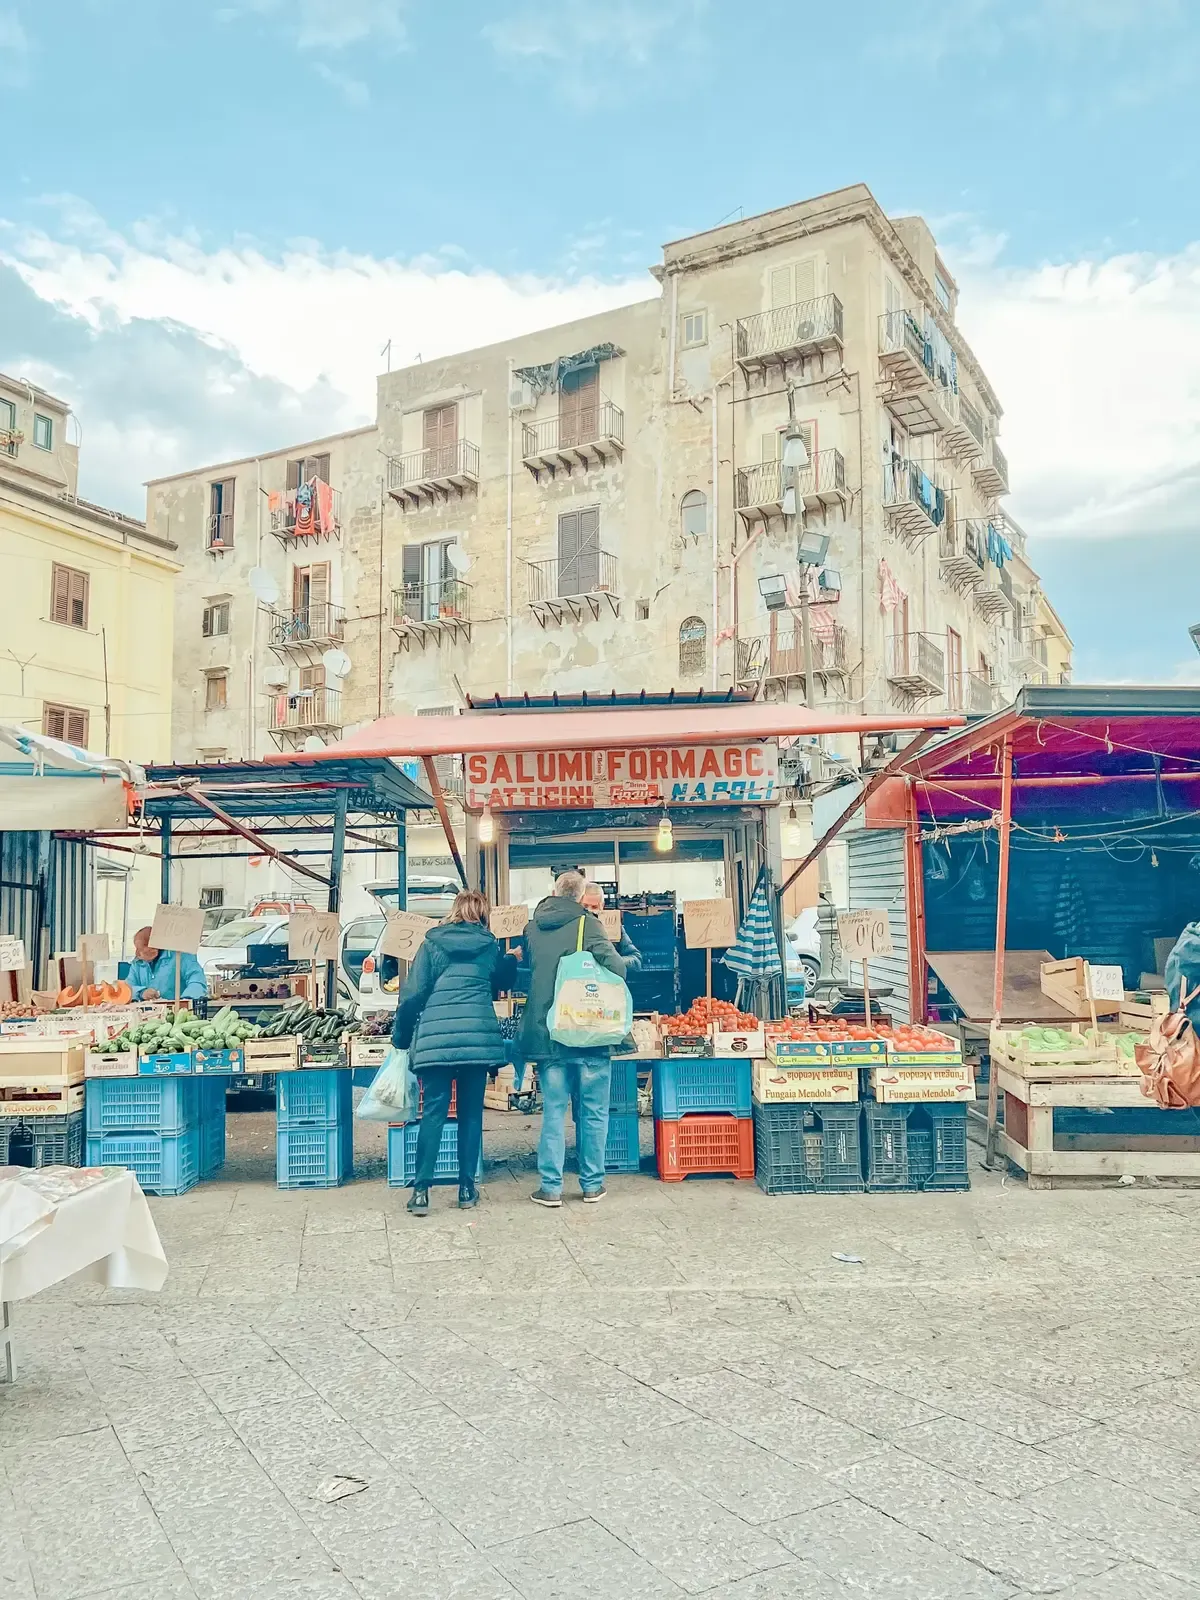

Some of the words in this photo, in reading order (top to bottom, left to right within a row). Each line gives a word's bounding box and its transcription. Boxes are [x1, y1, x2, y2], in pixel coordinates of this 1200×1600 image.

[469, 752, 593, 784] SALUMI
[469, 785, 594, 809] LATTICINI
[671, 780, 774, 802] NAPOLI
[786, 1071, 821, 1081] Mendola
[898, 1071, 932, 1080] Mendola
[765, 1089, 797, 1100] Fungaia
[798, 1088, 832, 1099] Mendola
[888, 1089, 920, 1100] Fungaia
[921, 1088, 955, 1098] Mendola
